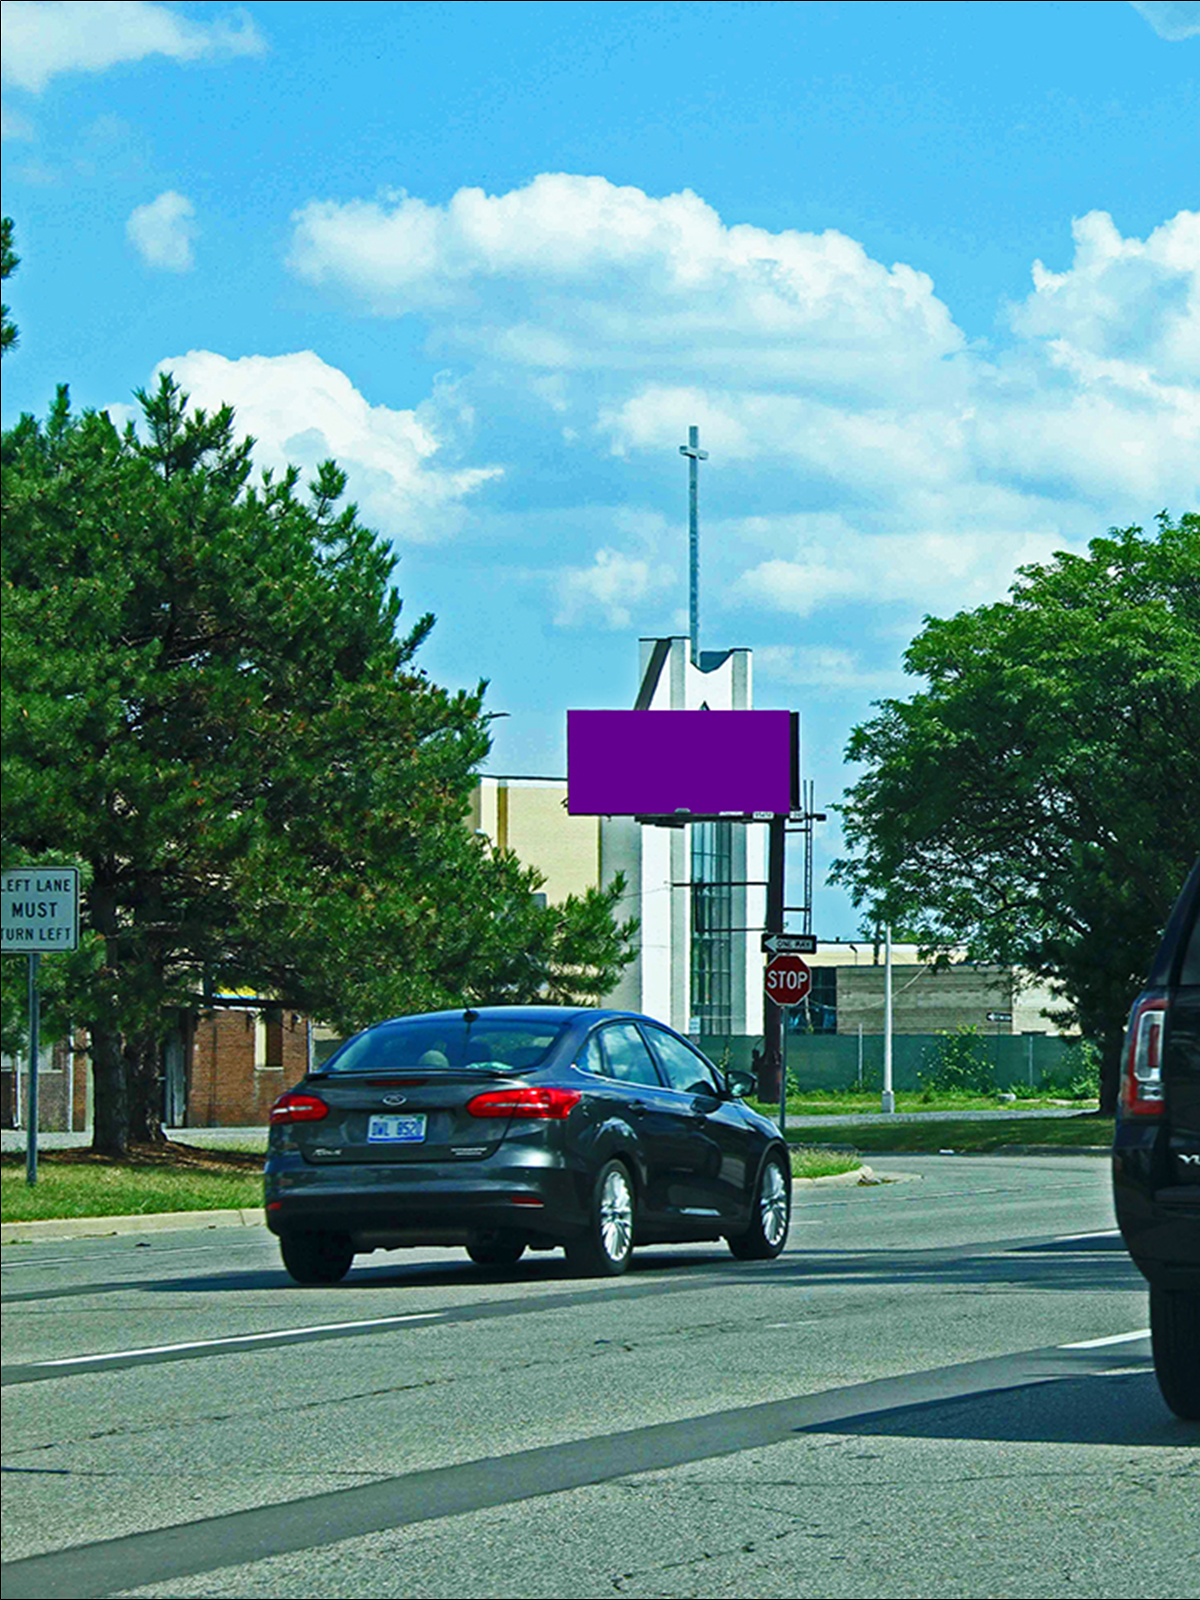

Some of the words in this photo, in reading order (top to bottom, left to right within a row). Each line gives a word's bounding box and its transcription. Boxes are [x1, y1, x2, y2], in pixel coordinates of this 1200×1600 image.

[36, 879, 71, 892] LANE
[12, 902, 58, 918] MUST
[1, 927, 34, 941] TURN
[40, 927, 71, 941] LEFT
[767, 970, 808, 990] STOP
